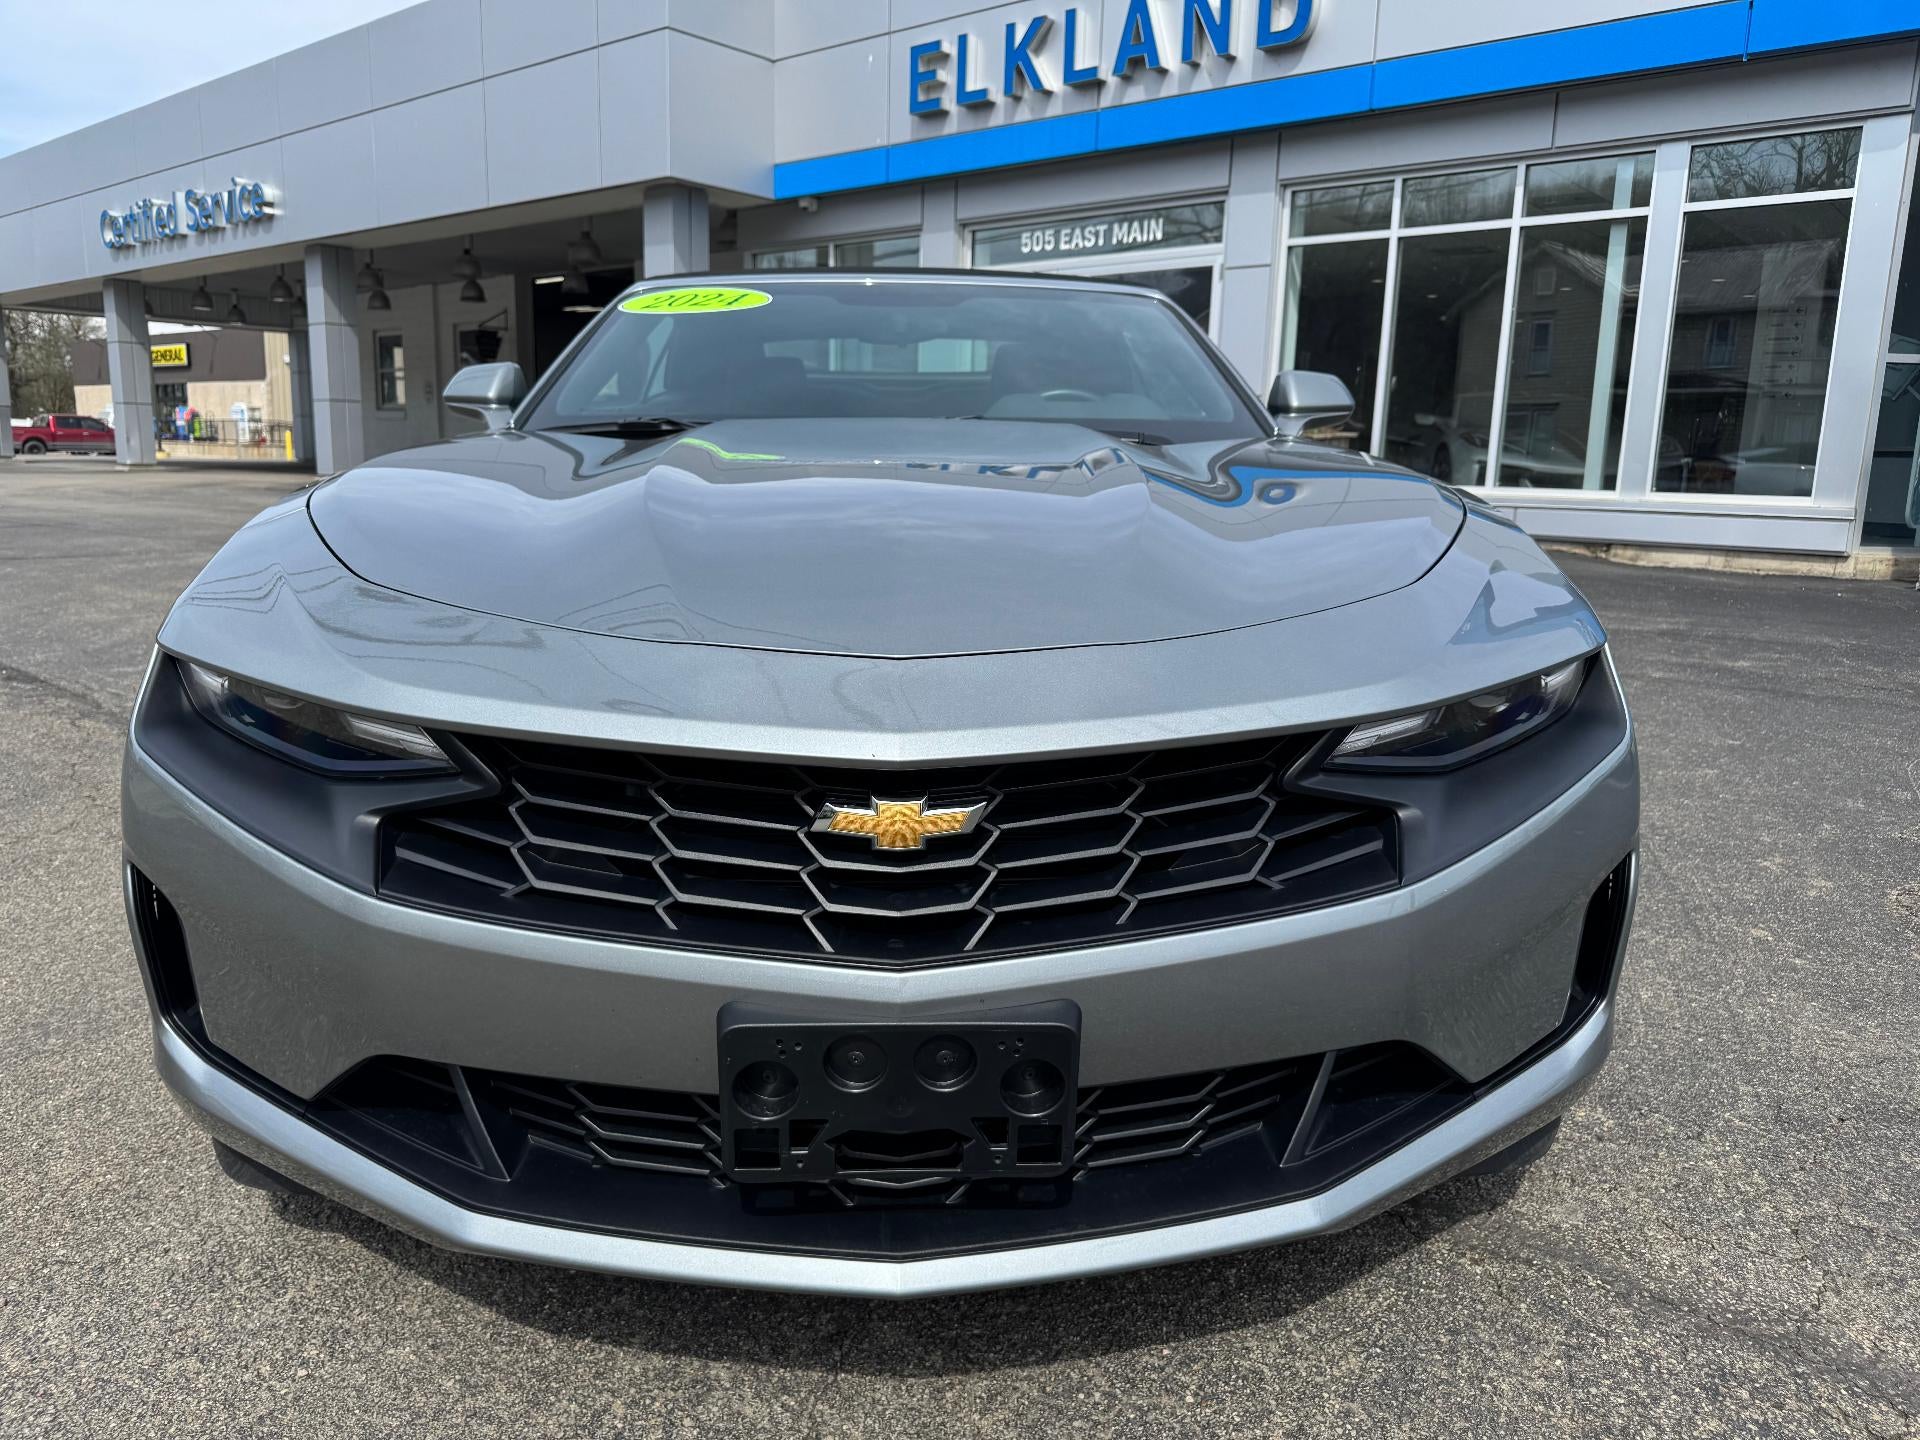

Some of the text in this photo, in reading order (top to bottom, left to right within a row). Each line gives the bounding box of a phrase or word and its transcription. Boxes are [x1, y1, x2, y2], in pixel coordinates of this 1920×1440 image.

[909, 0, 1315, 117] ELKLAND
[100, 177, 266, 249] Certified Service
[1020, 217, 1164, 254] 505 EAST MAIN
[641, 293, 750, 309] 2024
